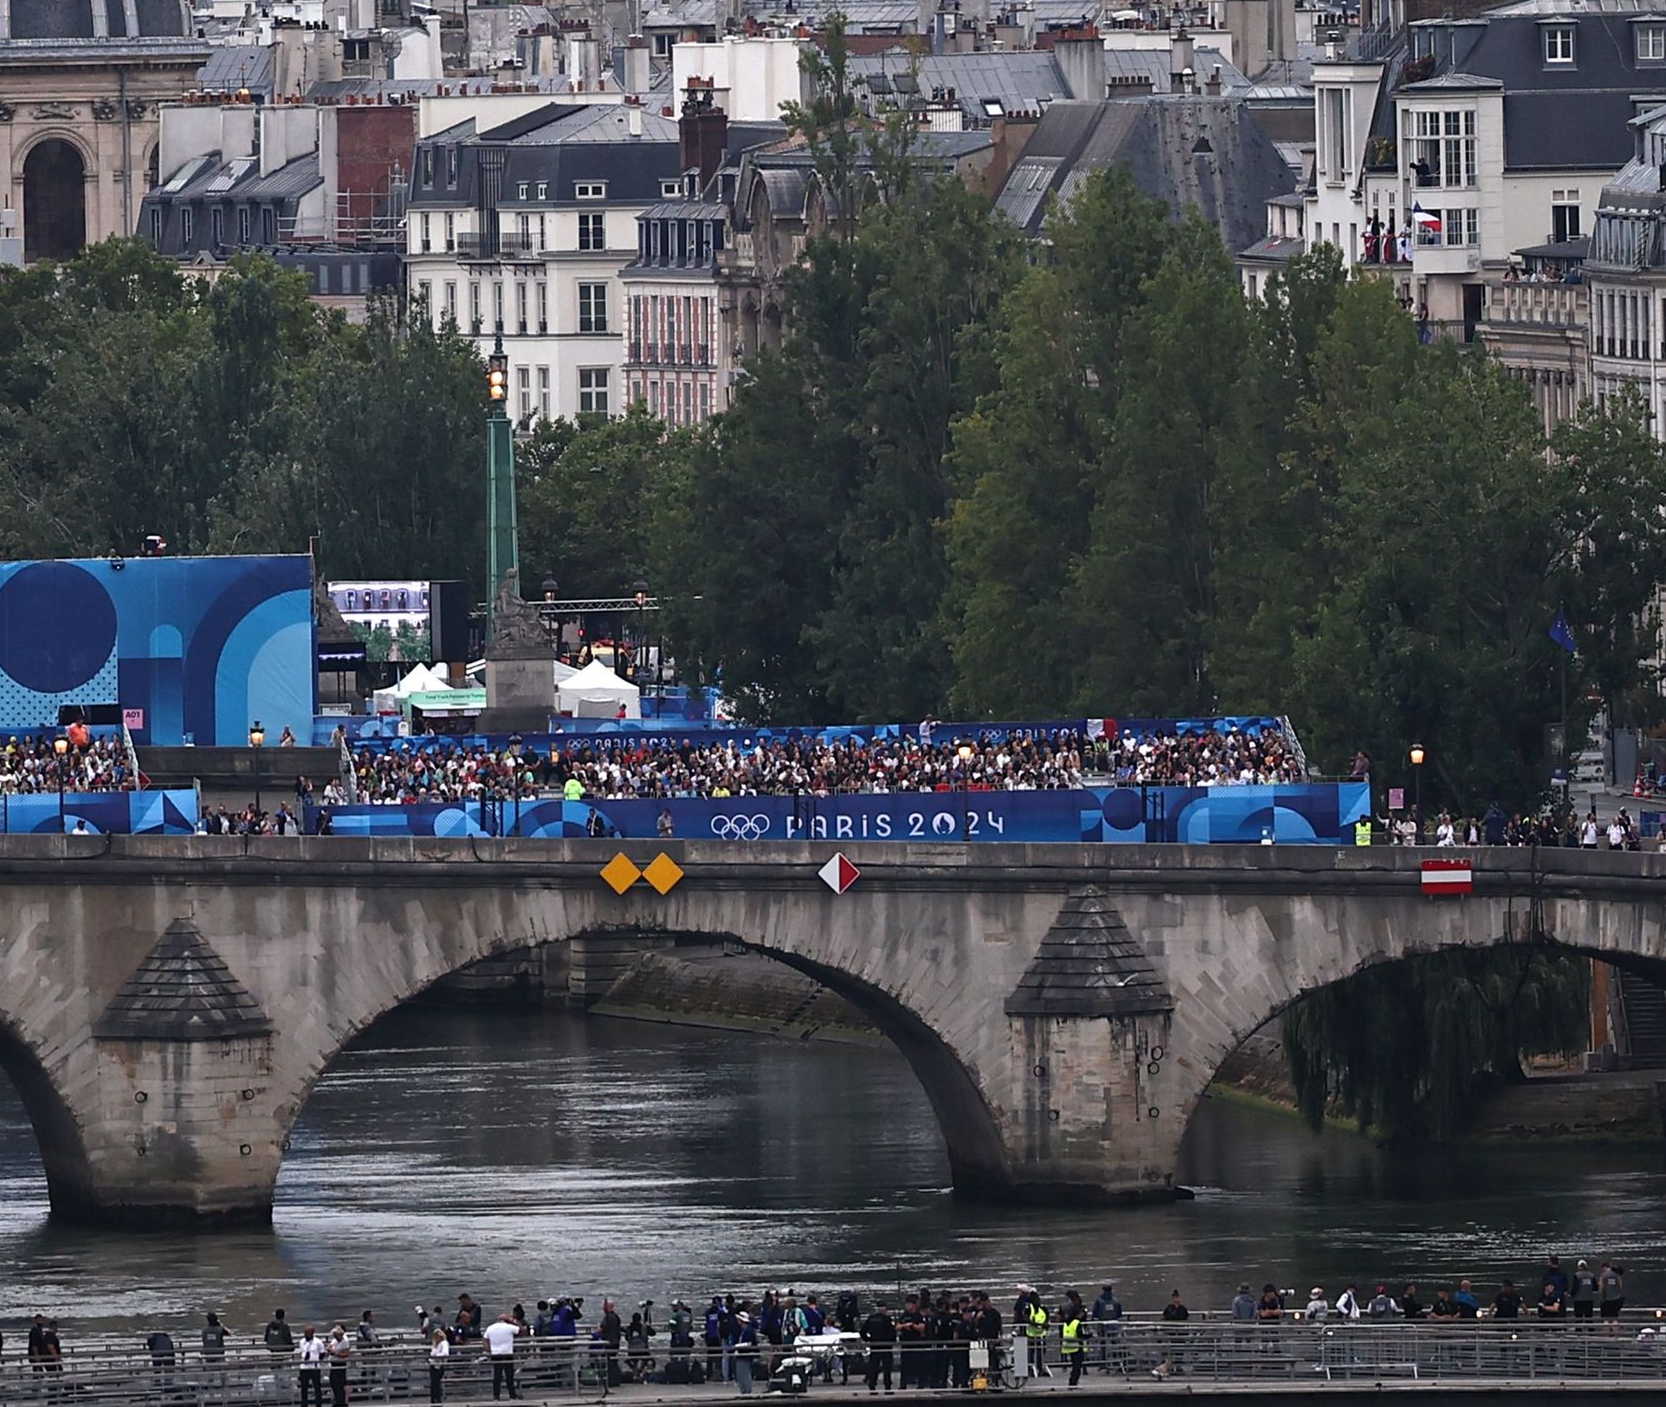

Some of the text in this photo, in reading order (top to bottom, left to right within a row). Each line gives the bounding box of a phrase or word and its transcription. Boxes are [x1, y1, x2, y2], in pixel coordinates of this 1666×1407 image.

[125, 711, 140, 719] A01
[786, 811, 1004, 839] PARIS 2024
